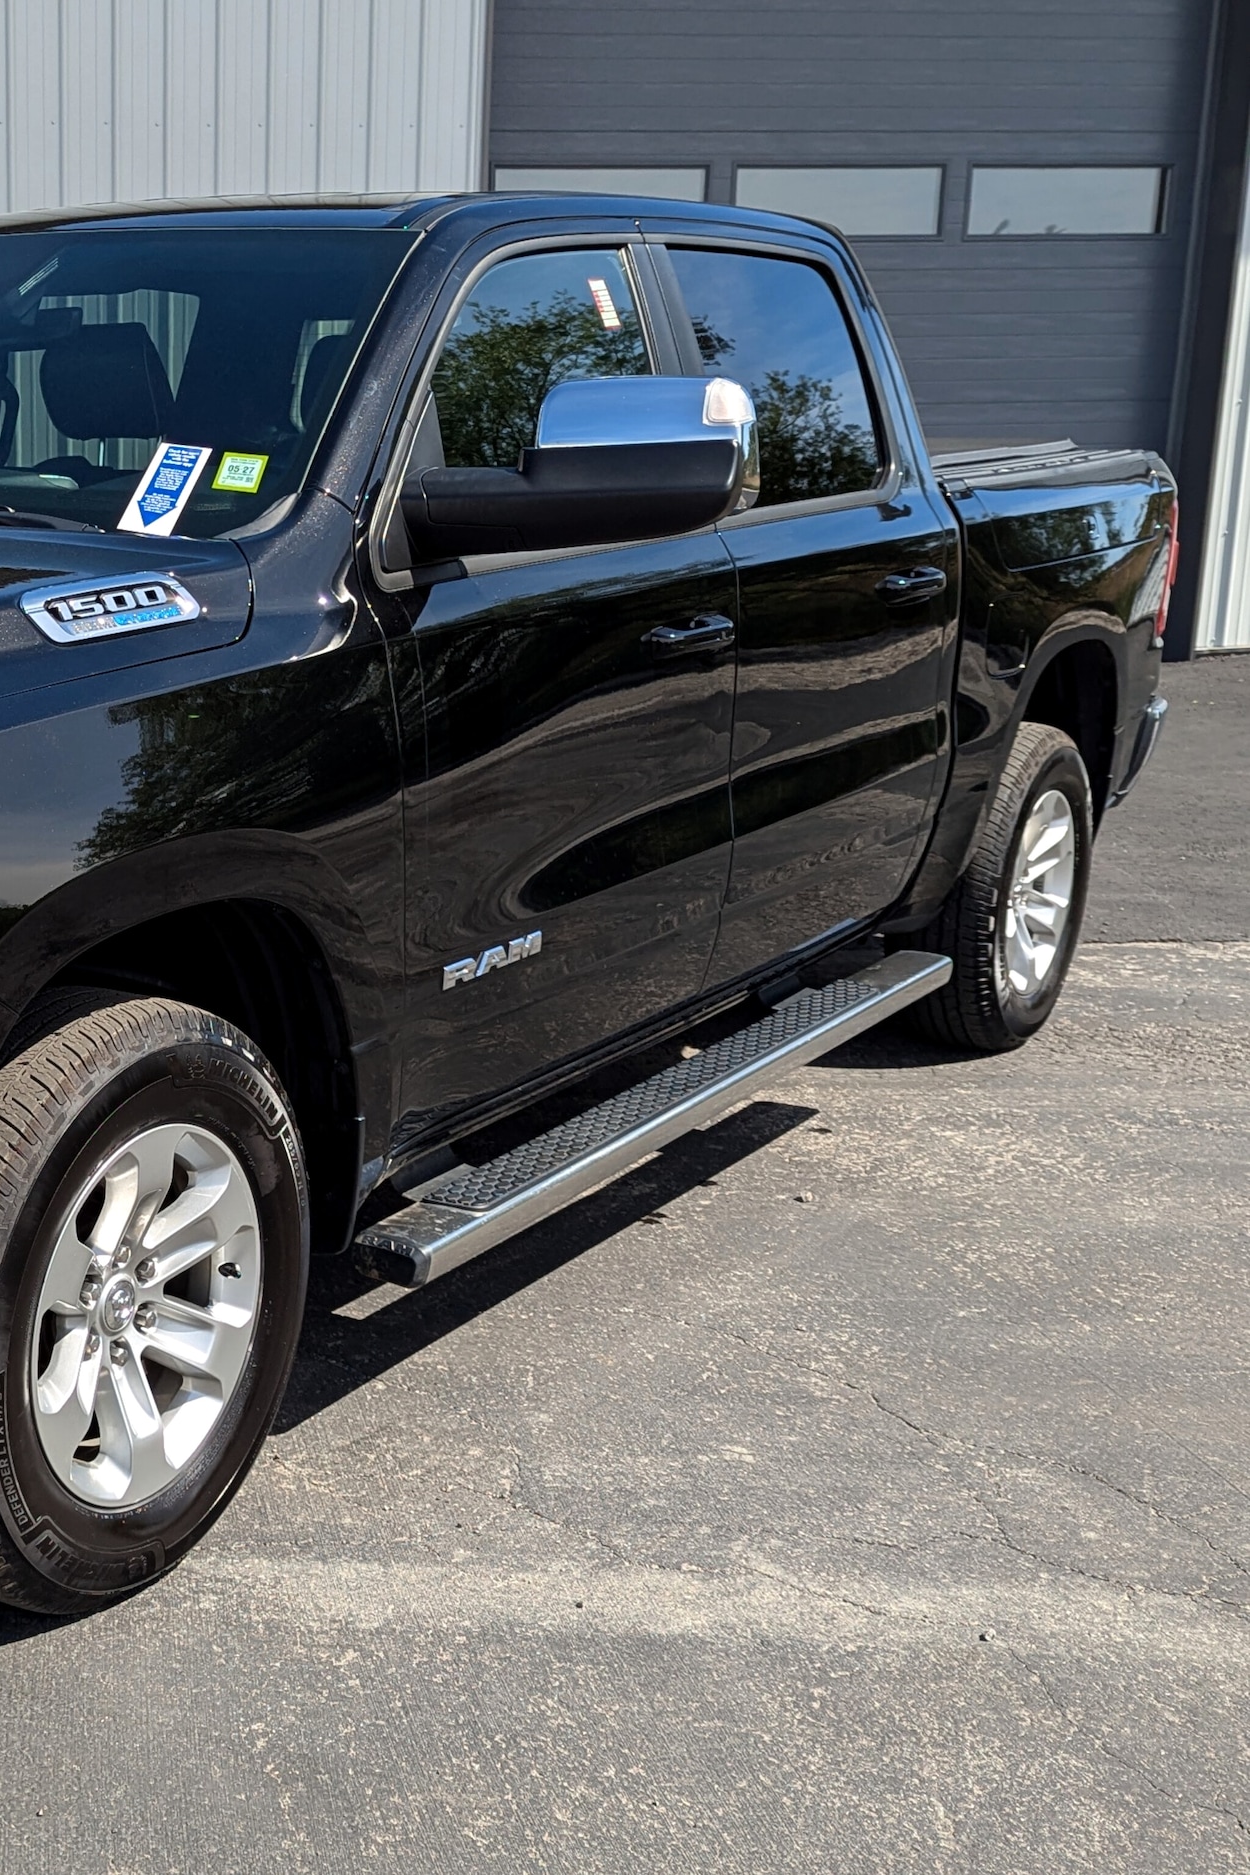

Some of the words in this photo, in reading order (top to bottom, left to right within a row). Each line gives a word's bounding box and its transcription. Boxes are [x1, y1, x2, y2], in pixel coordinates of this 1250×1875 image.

[227, 464, 240, 473] 05
[242, 466, 255, 474] 27
[48, 585, 168, 622] 1500
[442, 930, 543, 991] RAM
[209, 1057, 279, 1121] MICHELIN
[0, 1459, 29, 1526] DEFENDER
